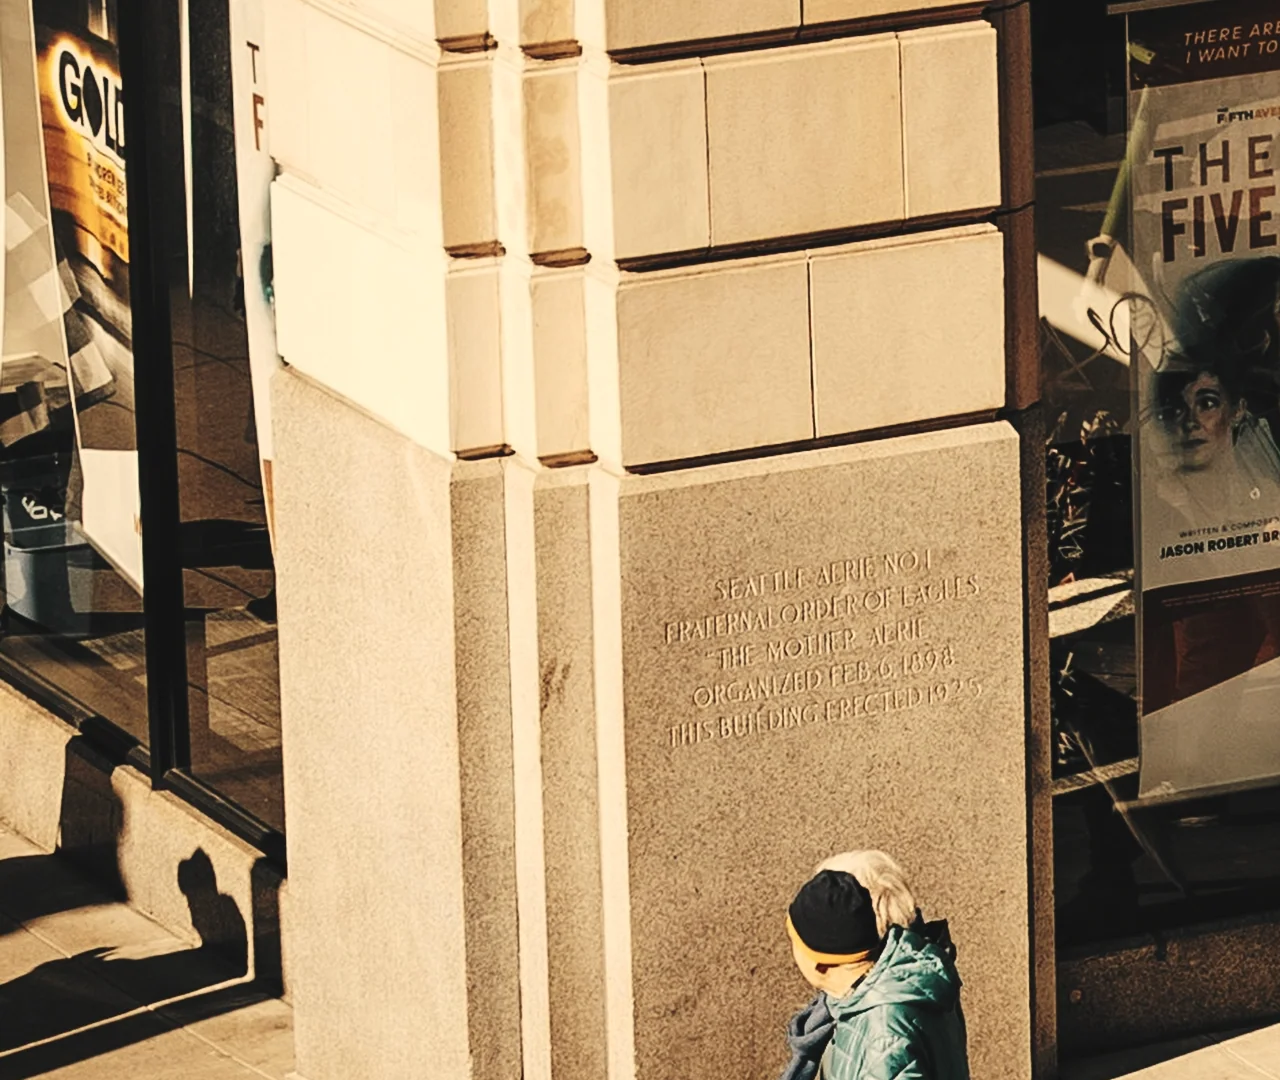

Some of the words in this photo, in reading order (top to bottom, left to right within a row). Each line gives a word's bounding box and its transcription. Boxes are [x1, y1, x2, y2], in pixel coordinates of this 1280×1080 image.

[1184, 26, 1242, 46] THERE
[1186, 51, 1191, 64] I
[1199, 43, 1251, 63] WANT
[1258, 40, 1278, 55] TO
[1153, 134, 1273, 192] THE
[1161, 185, 1277, 263] FIVE
[1160, 541, 1204, 559] JASON
[1208, 533, 1259, 552] ROBERT
[715, 566, 803, 600] SEATTLE
[816, 556, 877, 586] AERIE
[665, 606, 778, 644] FRATERNAL
[780, 593, 858, 624] ORDER
[863, 587, 892, 613] OF
[901, 574, 980, 607] EAGLES
[766, 628, 856, 662] MOTHER
[692, 669, 822, 708] ORGANIZED
[902, 645, 955, 676] 1898
[667, 720, 715, 748] THIS
[720, 702, 818, 739] BUILDING
[824, 686, 923, 722] ERECTED
